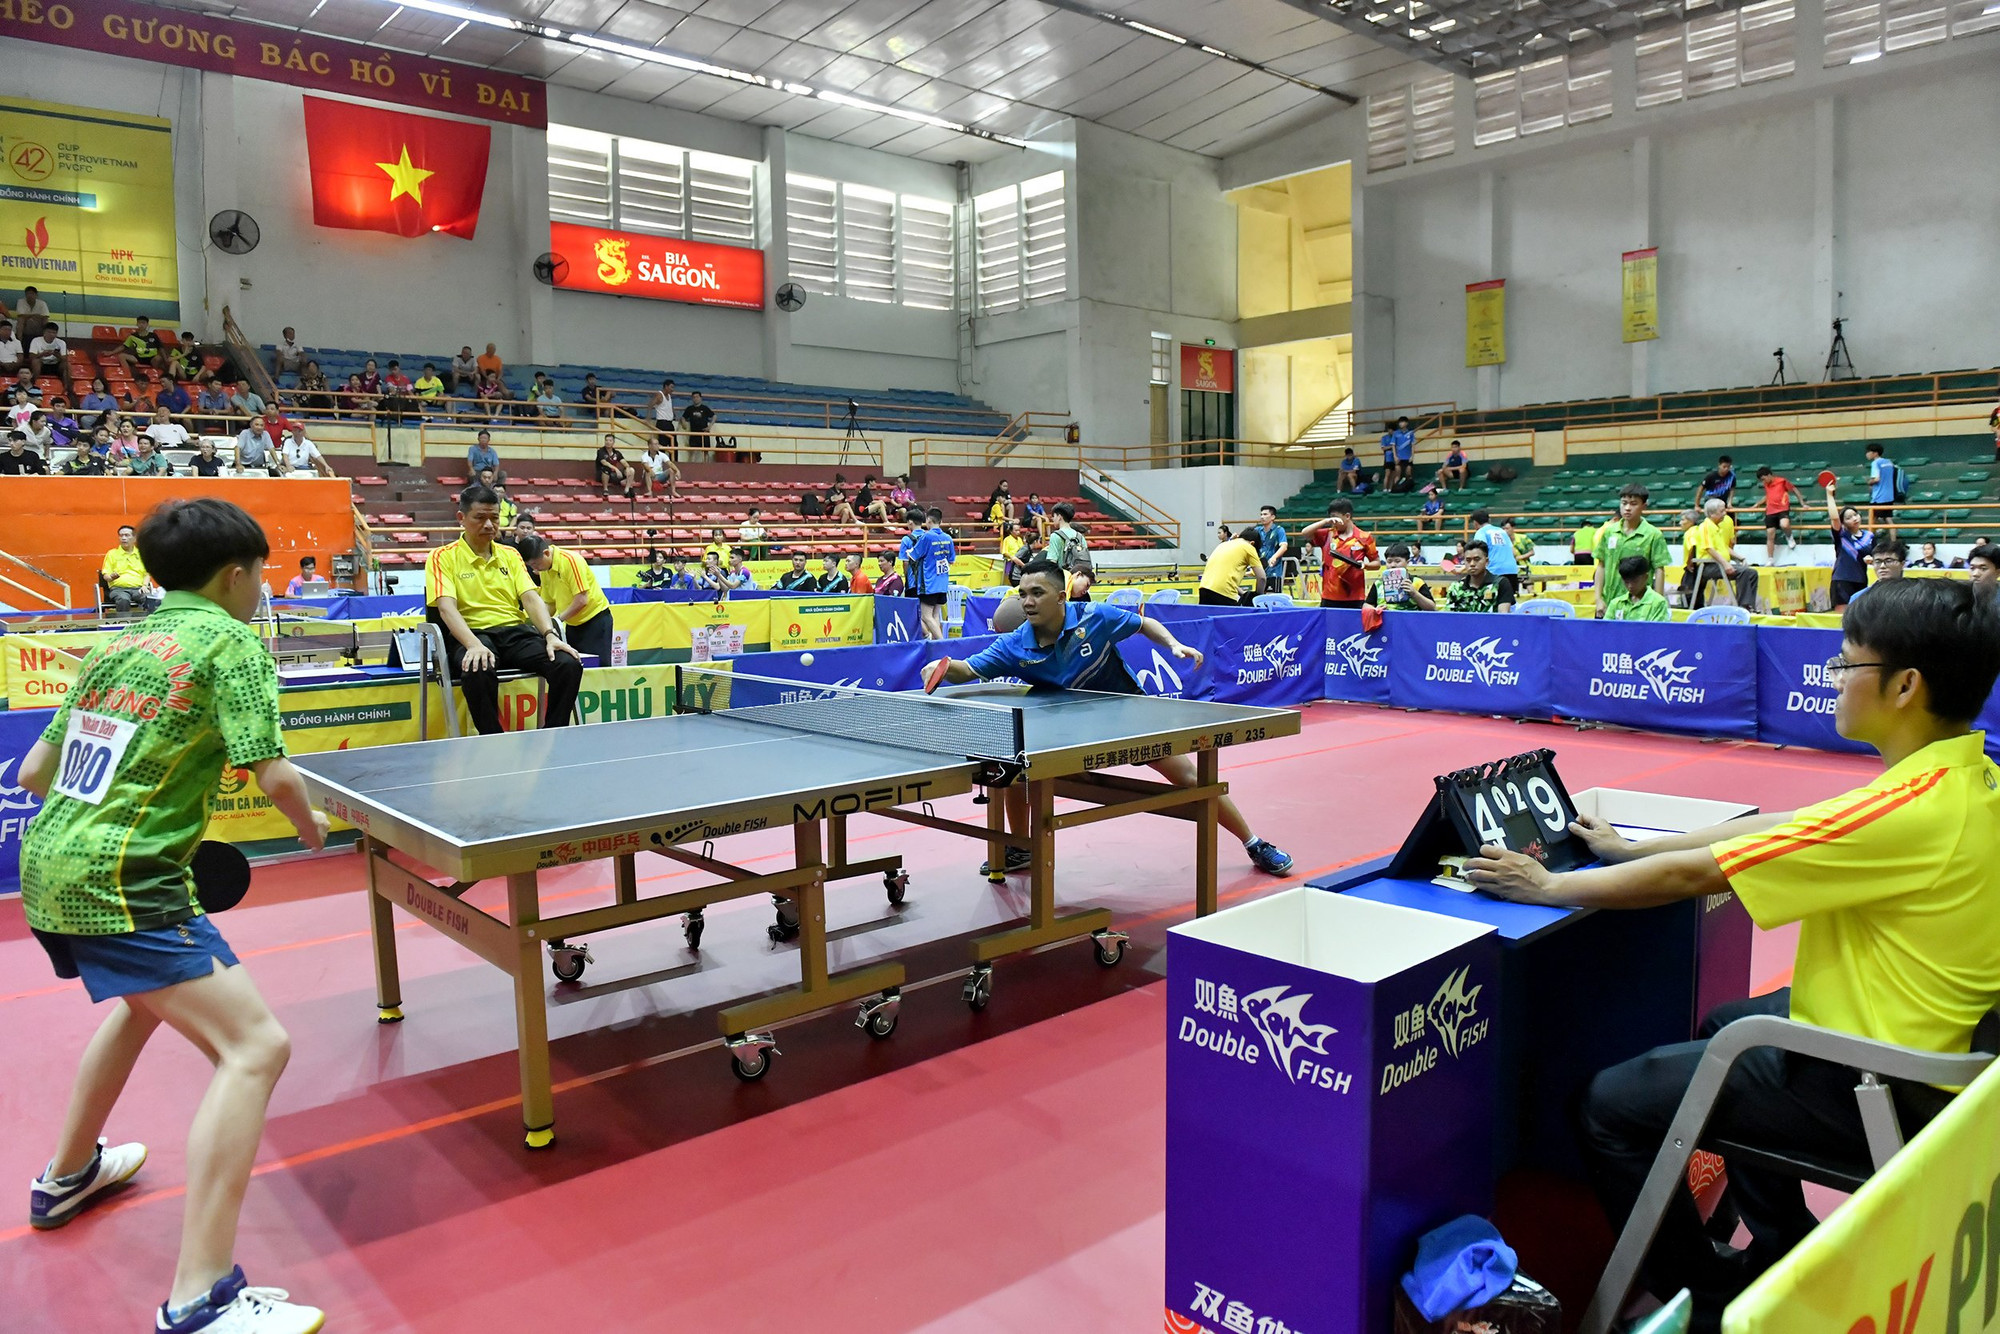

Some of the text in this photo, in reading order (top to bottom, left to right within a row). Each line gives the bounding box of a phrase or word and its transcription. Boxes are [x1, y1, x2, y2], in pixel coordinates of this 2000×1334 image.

[102, 13, 237, 60] GƯƠNG
[259, 38, 331, 74] BÁC
[349, 51, 396, 87] HỒ
[418, 68, 452, 98] VĨ
[476, 83, 531, 116] ĐẠI
[57, 142, 80, 151] CUP
[15, 146, 46, 174] 42
[57, 152, 138, 169] PETROVIETNAM
[1, 254, 77, 272] PETROVIETNAM
[110, 248, 134, 261] NPK
[665, 251, 690, 267] BIA
[97, 261, 148, 277] PHÚ MỸ
[1236, 663, 1302, 685] DOUBLE FISH
[1361, 664, 1388, 678] FISH
[1425, 664, 1520, 686] DOUBLE FISH
[25, 680, 68, 696] Cho
[1589, 678, 1706, 704] DOUBLE FISH
[578, 676, 652, 725] PHÚ
[1786, 691, 1837, 715] DOUB
[290, 710, 322, 726] ĐỒNG
[324, 709, 355, 724] HÀNH
[358, 708, 391, 721] CHÍNH
[1245, 727, 1266, 742] 235
[61, 738, 112, 795] 080
[1082, 741, 1173, 771] 世乒赛器材供应商
[793, 780, 933, 825] MOFIT
[1491, 781, 1528, 816] 0 2
[1527, 776, 1567, 833] 9
[702, 816, 768, 838] Double FISH
[1475, 792, 1508, 850] 4
[581, 832, 641, 855] 中国乒乓
[536, 855, 582, 869] Double FISH
[407, 882, 469, 935] DOUBLE FISH
[1194, 977, 1240, 1023] 双魚
[1393, 1003, 1426, 1050] 双魚
[1178, 1016, 1353, 1095] Double FISH
[1380, 1017, 1489, 1096] Double FISH
